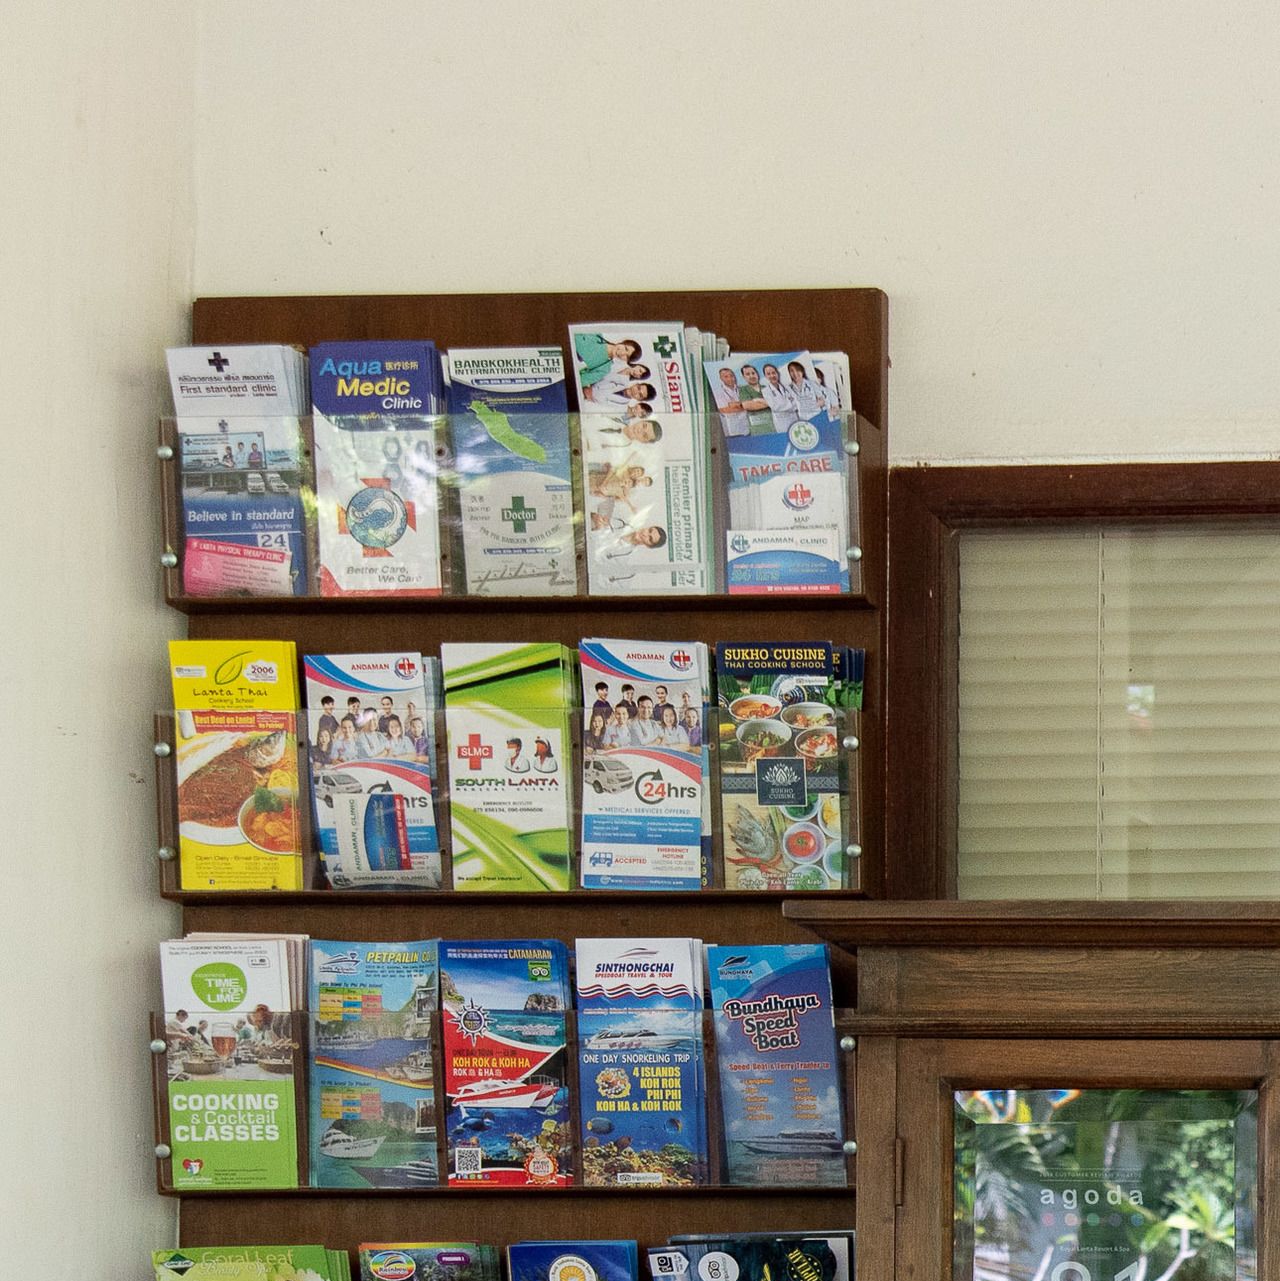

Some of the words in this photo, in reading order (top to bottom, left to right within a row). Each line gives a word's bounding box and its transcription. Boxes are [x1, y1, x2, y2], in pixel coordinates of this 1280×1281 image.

[319, 358, 382, 379] Aqua
[454, 359, 561, 369] BANGKOKHEALTH
[180, 385, 202, 394] First
[206, 384, 248, 394] standard
[252, 384, 277, 393] clinic
[336, 377, 411, 396] Medic
[664, 361, 683, 414] Siam
[382, 397, 423, 409] Clinic
[188, 510, 228, 522] Believe
[232, 511, 243, 520] in
[247, 508, 295, 520] standard
[503, 510, 536, 520] Doctor
[724, 649, 769, 660] SUKHO
[773, 649, 826, 660] CUISINE
[725, 661, 745, 669] THAI
[747, 661, 788, 669] COOKING
[790, 661, 826, 669] SCHOOL
[460, 747, 490, 757] SLMC
[455, 778, 505, 787] SOUTH
[508, 778, 559, 786] LANTA
[508, 948, 553, 960] CATAMARAN
[595, 963, 674, 973] SINTHONGCHAI
[204, 978, 240, 987] TIME
[207, 994, 241, 1003] LIME
[725, 994, 819, 1018] Bundhaya
[745, 1012, 797, 1034] Speed
[754, 1032, 798, 1050] Boat
[453, 1057, 471, 1068] KOH
[472, 1057, 490, 1068] ROK
[499, 1057, 517, 1068] KOH
[518, 1056, 531, 1068] HA
[583, 1054, 599, 1064] ONE
[603, 1054, 618, 1064] DAY
[621, 1053, 670, 1064] SNORKELING
[673, 1053, 691, 1064] TRIP
[453, 1068, 468, 1077] ROK
[633, 1067, 640, 1077] 4
[640, 1067, 681, 1077] ISLANDS
[640, 1078, 660, 1089] KOH
[661, 1078, 681, 1089] ROK
[647, 1089, 665, 1100] PHI
[665, 1089, 682, 1100] PHI
[172, 1094, 280, 1111] COOKING
[596, 1101, 617, 1112] KOH
[618, 1101, 631, 1112] HA
[641, 1101, 661, 1112] KOH
[662, 1101, 683, 1112] ROK
[190, 1113, 201, 1125] &
[204, 1110, 276, 1125] Cocktail
[175, 1124, 280, 1142] CLASSES
[1040, 1185, 1144, 1210] agoda
